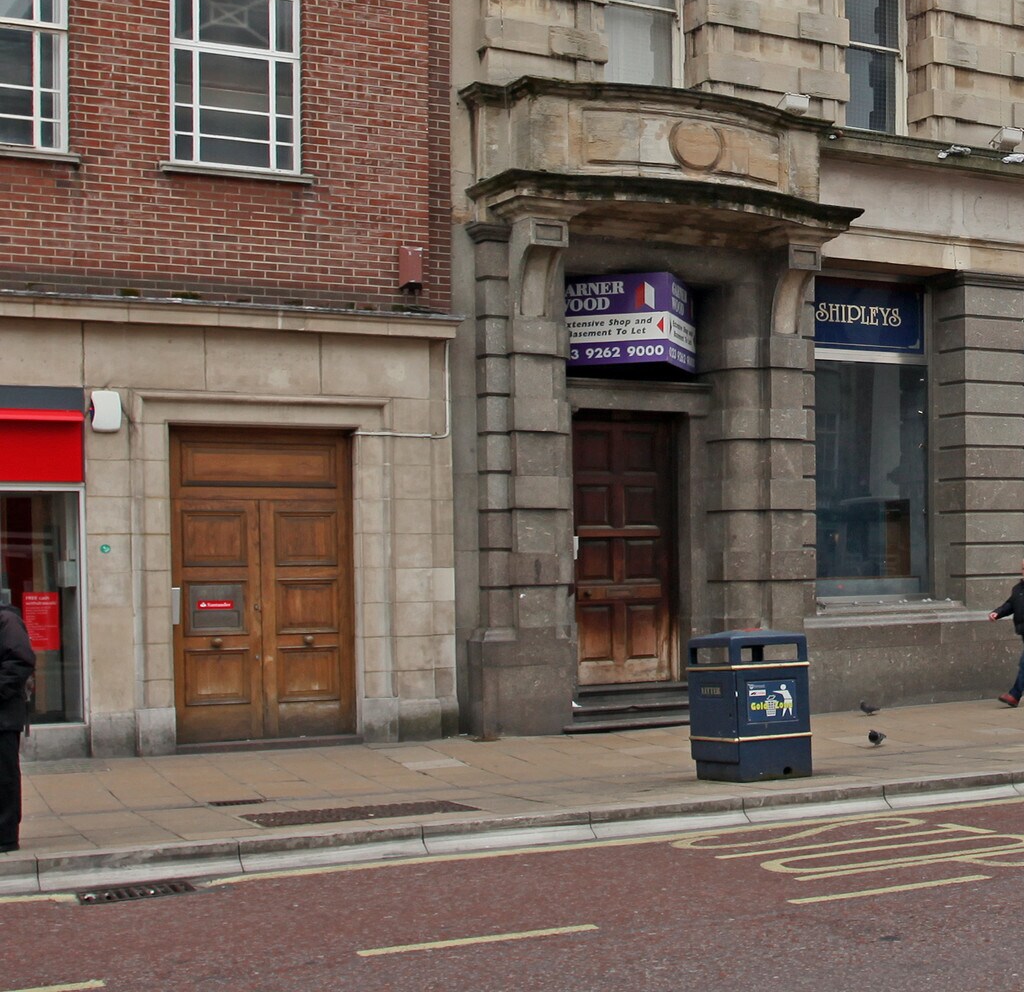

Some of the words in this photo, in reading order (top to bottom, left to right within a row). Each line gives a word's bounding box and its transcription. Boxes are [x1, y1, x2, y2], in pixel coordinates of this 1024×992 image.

[565, 281, 624, 296] ARNER
[816, 302, 901, 327] SHIPLEYS
[566, 319, 605, 328] xtensive
[608, 318, 631, 327] Shop
[634, 317, 653, 325] and
[631, 327, 647, 335] Let
[585, 347, 621, 359] 9262
[626, 344, 664, 357] 9000
[750, 701, 768, 711] Gold
